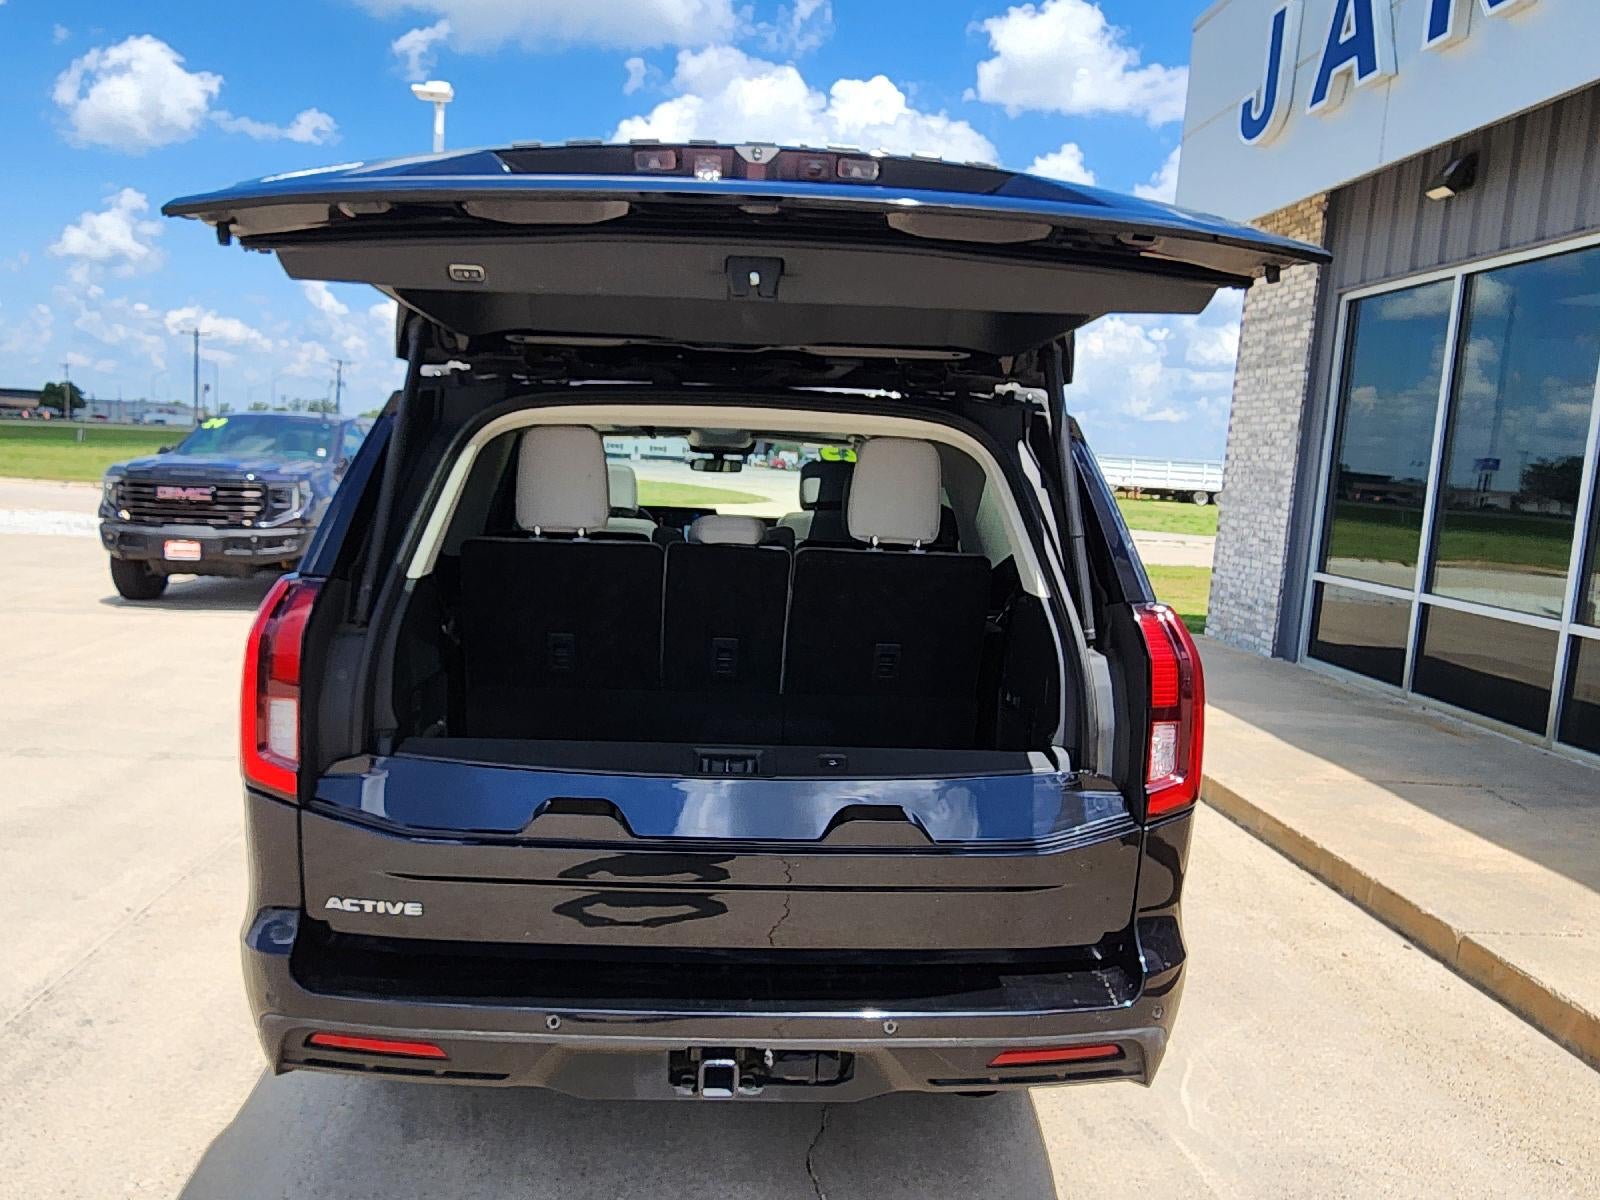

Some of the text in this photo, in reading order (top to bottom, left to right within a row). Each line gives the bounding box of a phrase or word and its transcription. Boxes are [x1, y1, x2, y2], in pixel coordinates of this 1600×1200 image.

[1238, 0, 1530, 145] JA
[156, 486, 214, 501] GMC
[325, 897, 423, 916] ACTIVE
